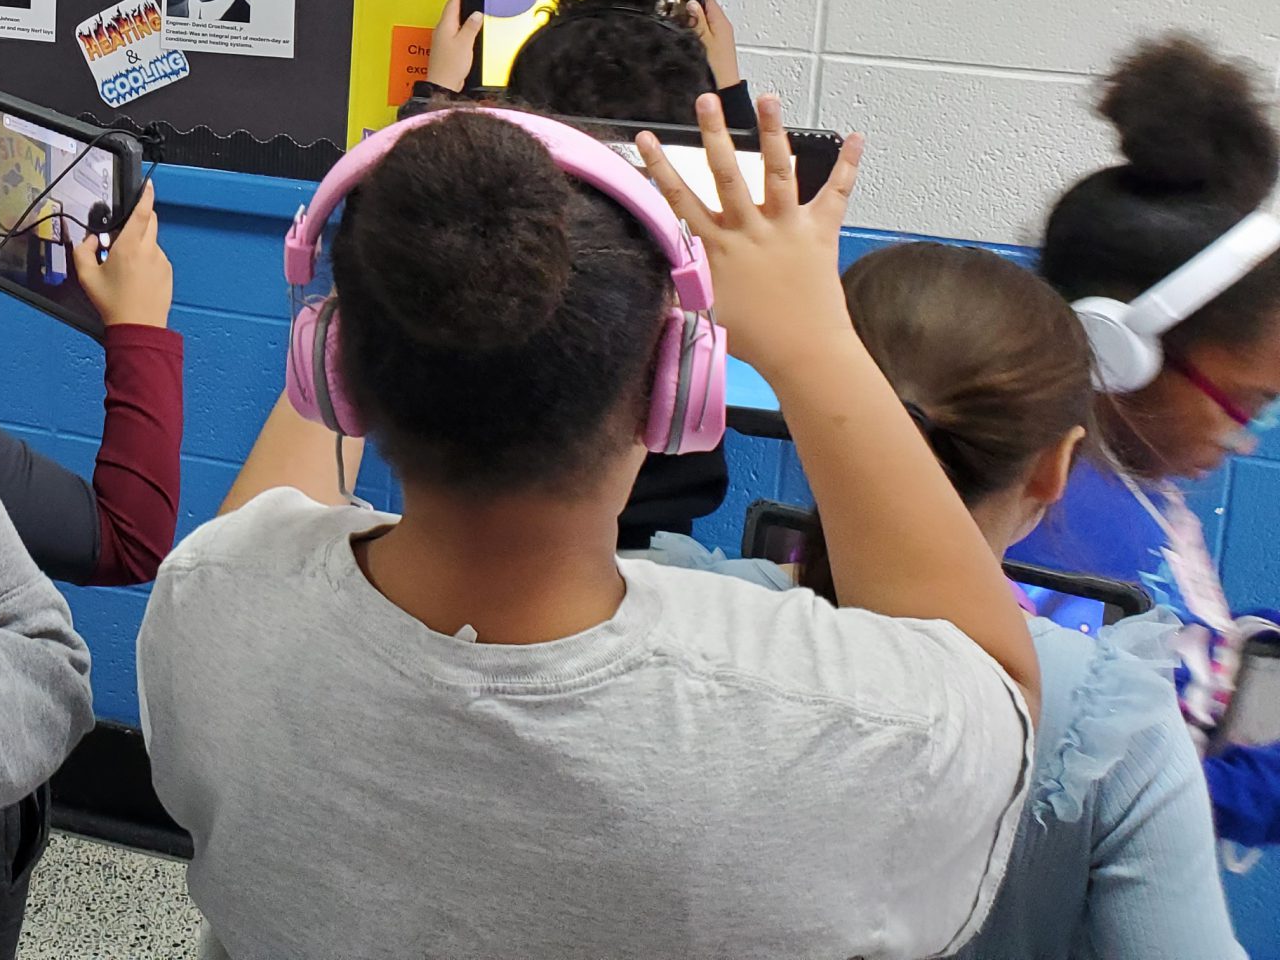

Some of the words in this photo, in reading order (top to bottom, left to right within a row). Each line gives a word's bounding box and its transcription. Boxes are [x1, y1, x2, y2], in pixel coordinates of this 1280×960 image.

[79, 8, 161, 61] HEATING
[126, 50, 141, 64] &
[408, 45, 430, 56] Che
[101, 50, 187, 103] COOLING
[407, 66, 428, 74] exc
